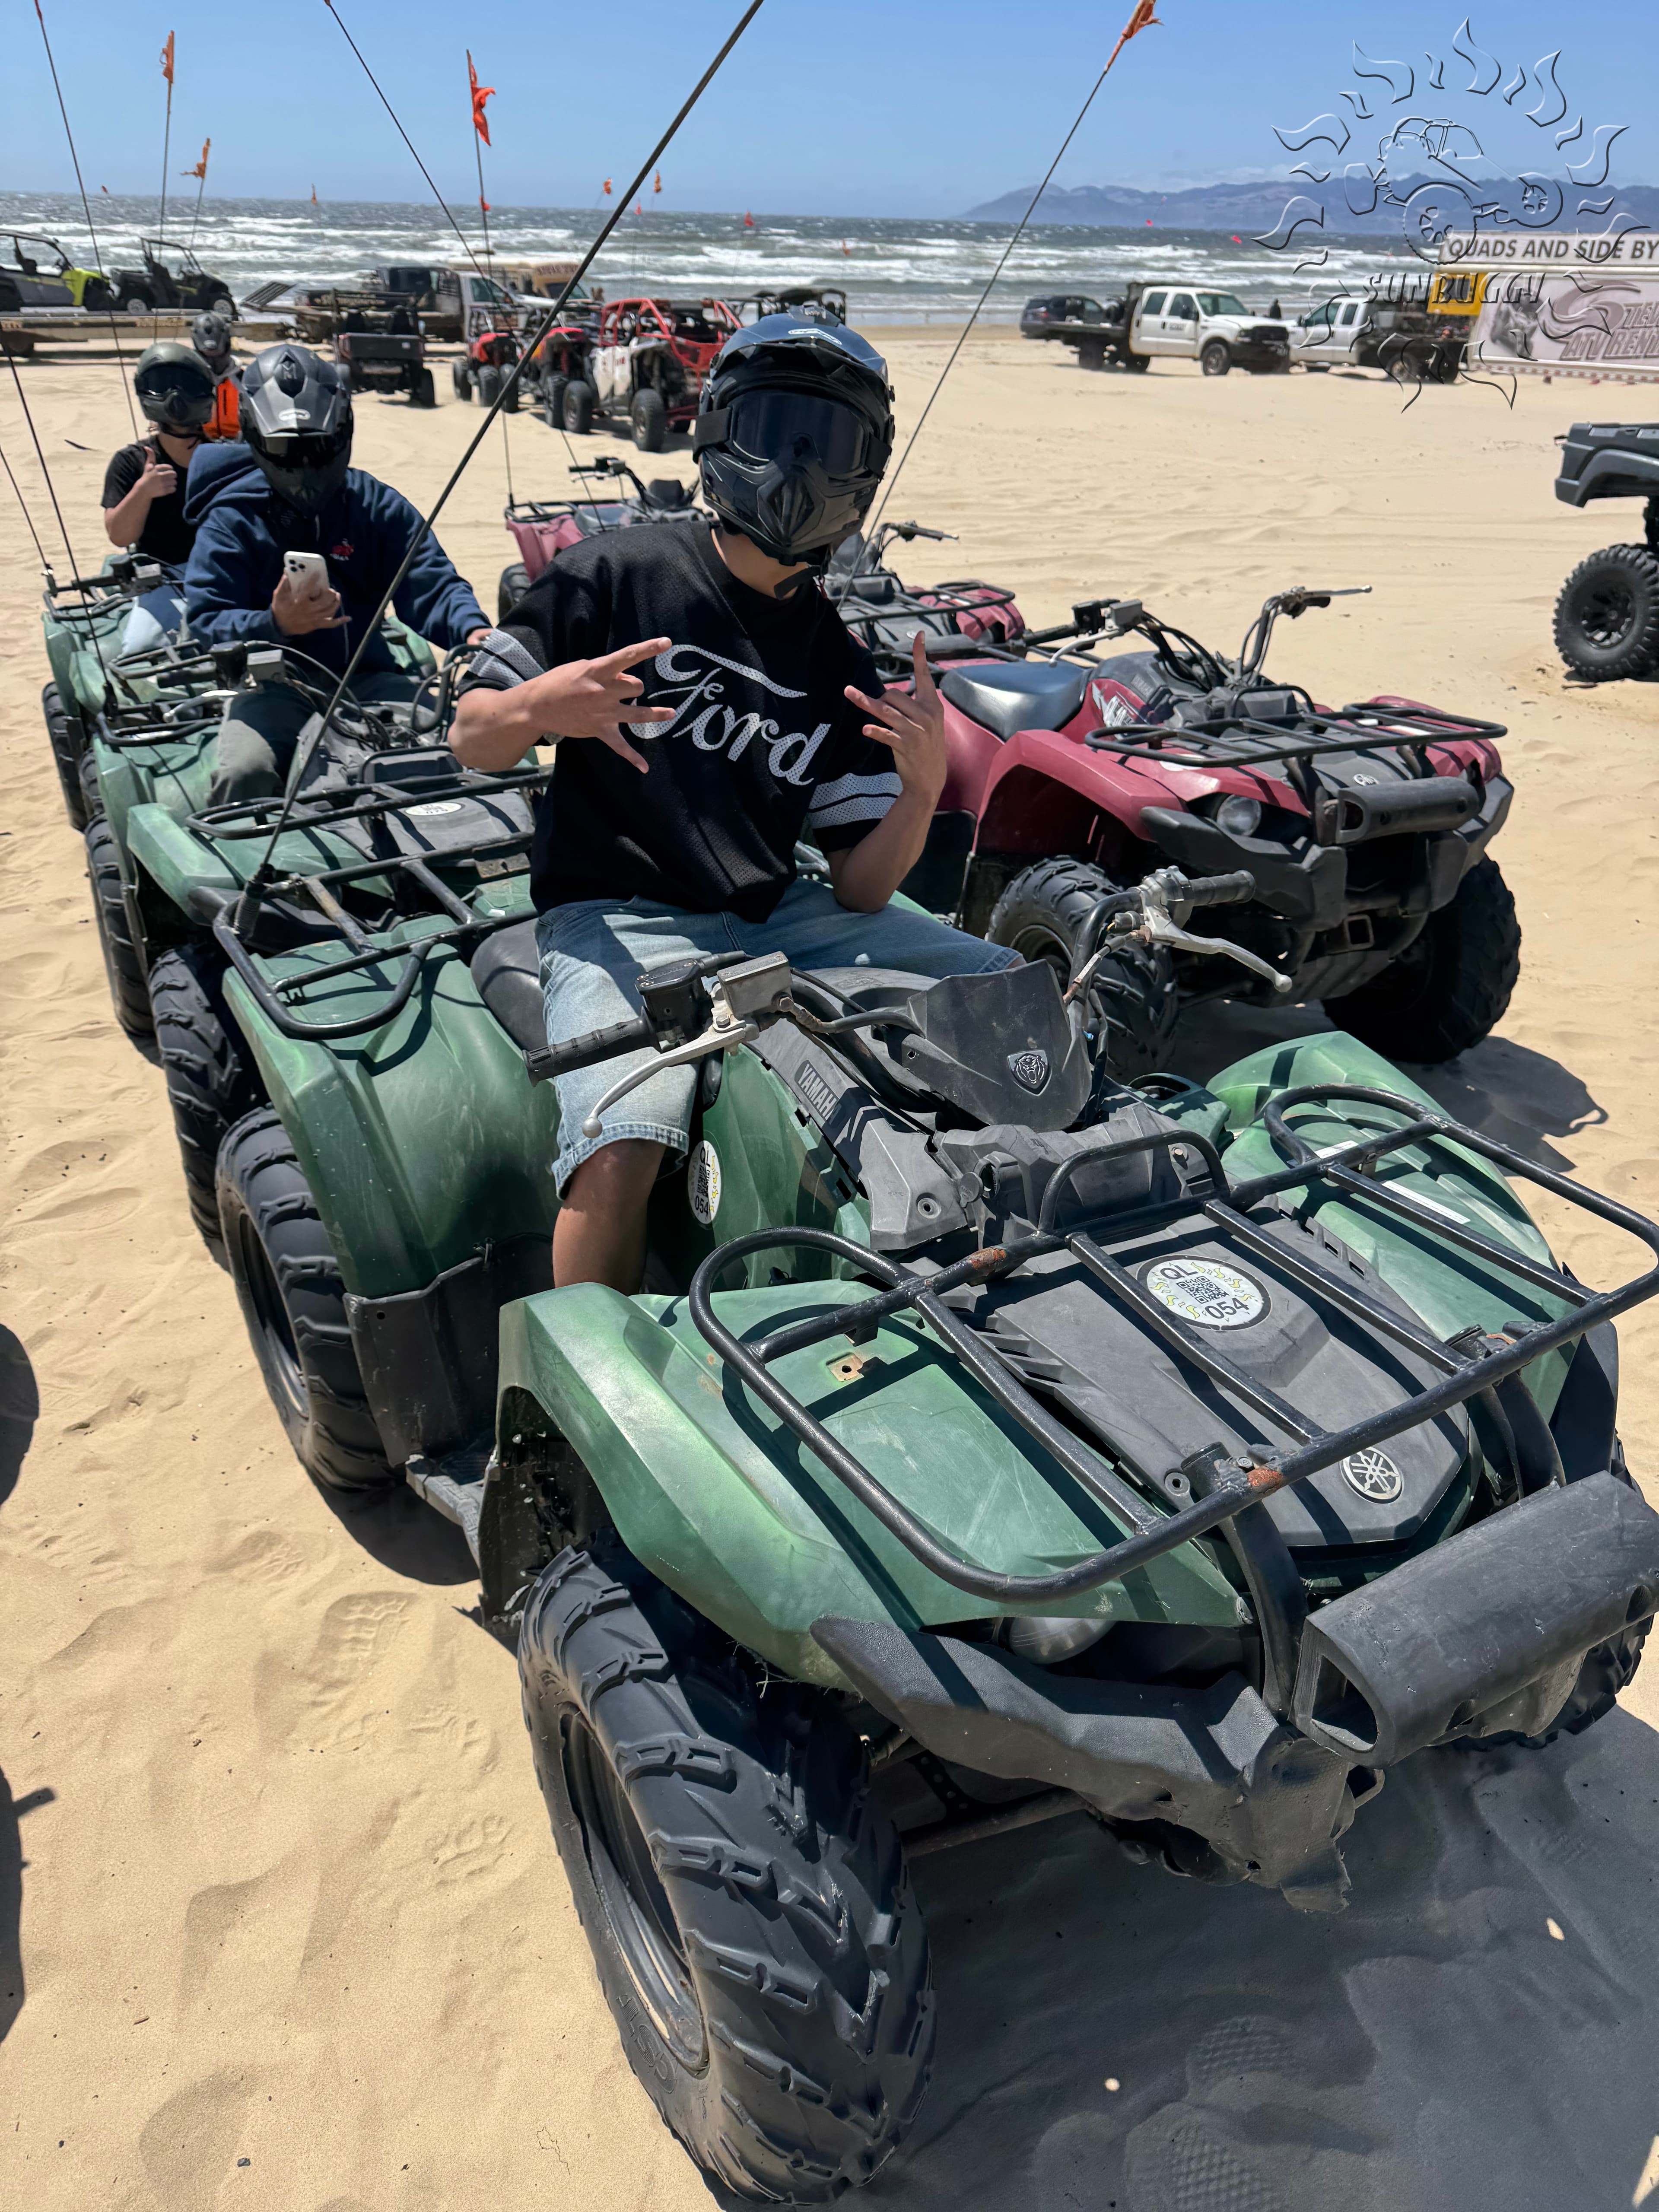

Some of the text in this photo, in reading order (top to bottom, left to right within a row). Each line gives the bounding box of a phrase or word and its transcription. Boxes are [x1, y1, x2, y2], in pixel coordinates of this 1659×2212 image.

[1449, 239, 1659, 259] QUADS AND SIDE BY
[628, 644, 831, 785] Ford
[700, 1147, 711, 1167] QL
[695, 1195, 711, 1217] 054
[1160, 1265, 1198, 1280] QL
[1205, 1297, 1250, 1319] 054
